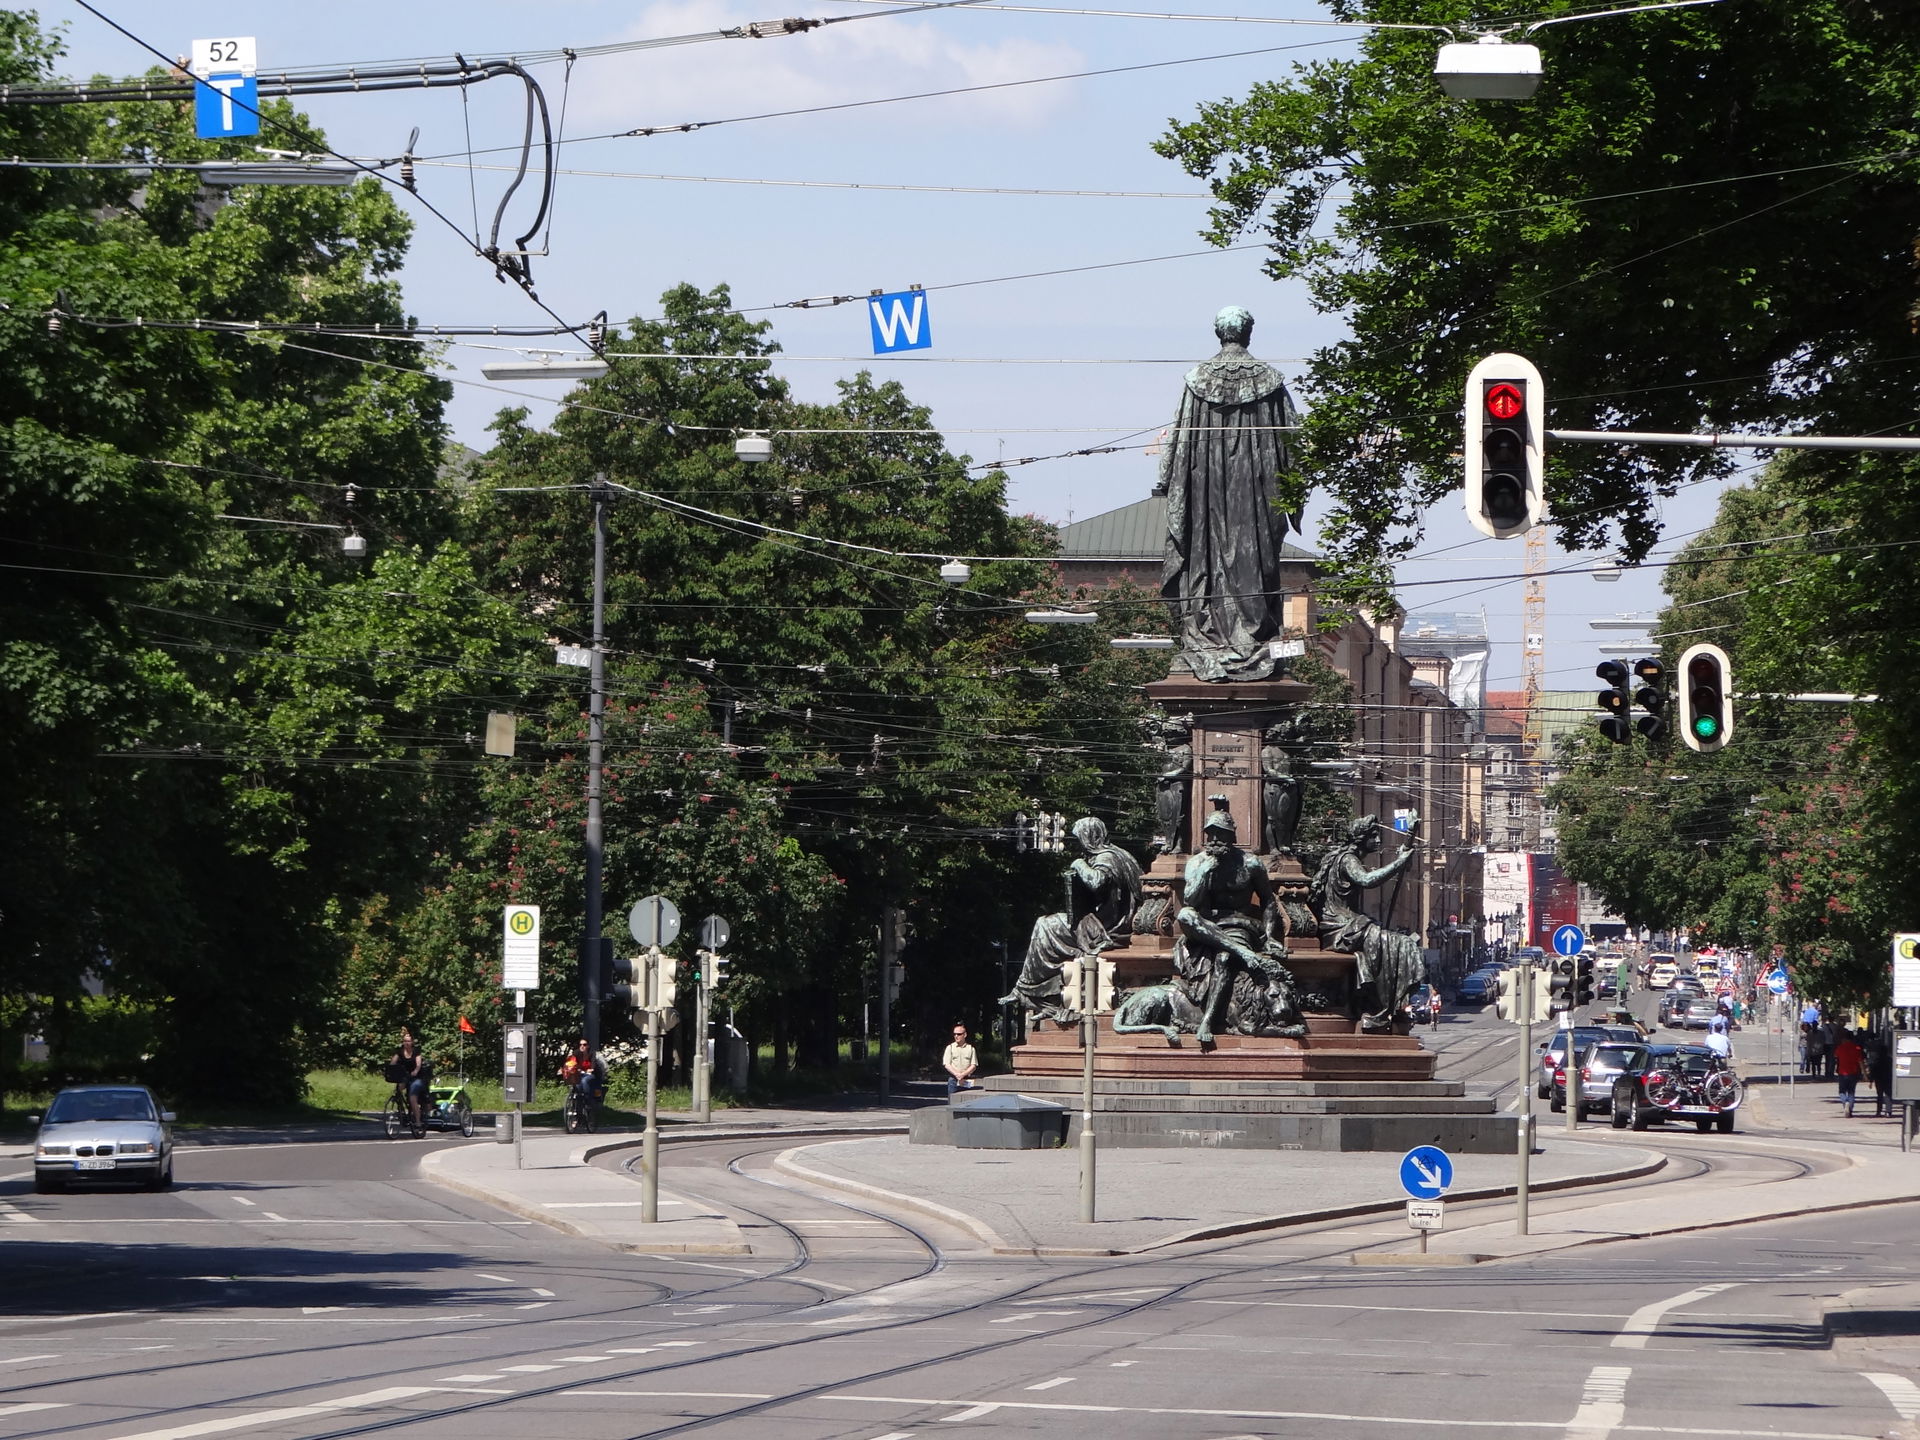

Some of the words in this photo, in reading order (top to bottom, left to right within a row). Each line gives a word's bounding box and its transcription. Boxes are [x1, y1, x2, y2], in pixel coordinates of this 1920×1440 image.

[209, 40, 239, 62] 52
[207, 78, 245, 131] T
[870, 296, 923, 348] W
[559, 650, 588, 667] 564
[1274, 643, 1299, 657] 565
[1398, 817, 1407, 830] T
[516, 915, 528, 930] H
